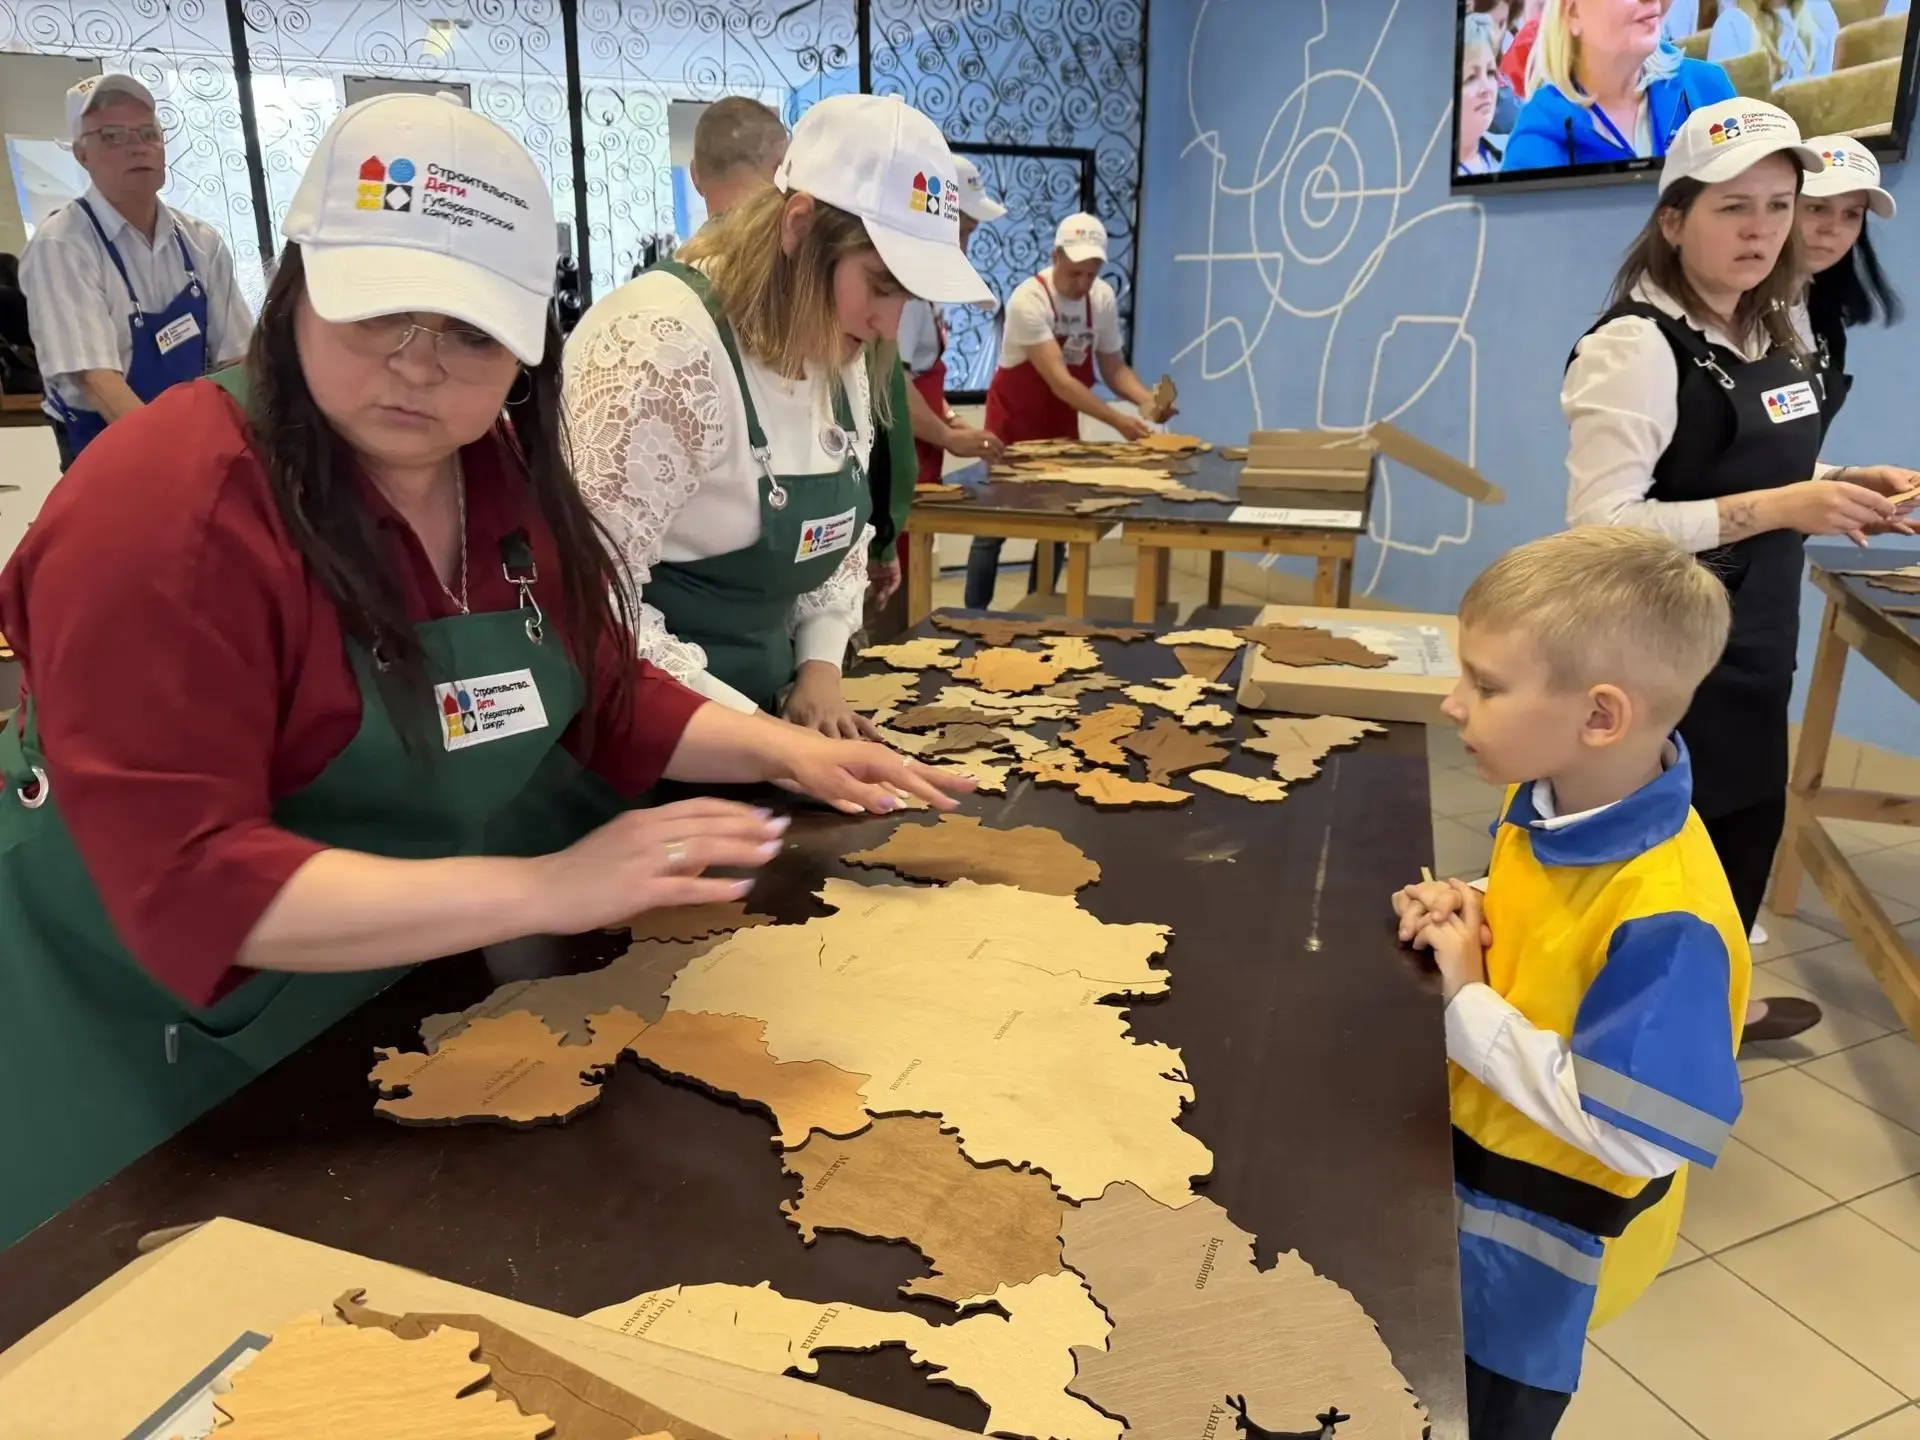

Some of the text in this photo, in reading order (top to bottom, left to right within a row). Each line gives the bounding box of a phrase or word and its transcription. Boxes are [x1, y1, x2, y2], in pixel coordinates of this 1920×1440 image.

[425, 177, 467, 198] Дети
[476, 698, 496, 712] Дети
[480, 704, 526, 722] Губернаторский
[812, 1157, 850, 1191] Магадан
[1195, 1237, 1224, 1290] Билибино
[800, 1307, 839, 1350] Палана
[1201, 1404, 1226, 1440] Анад
